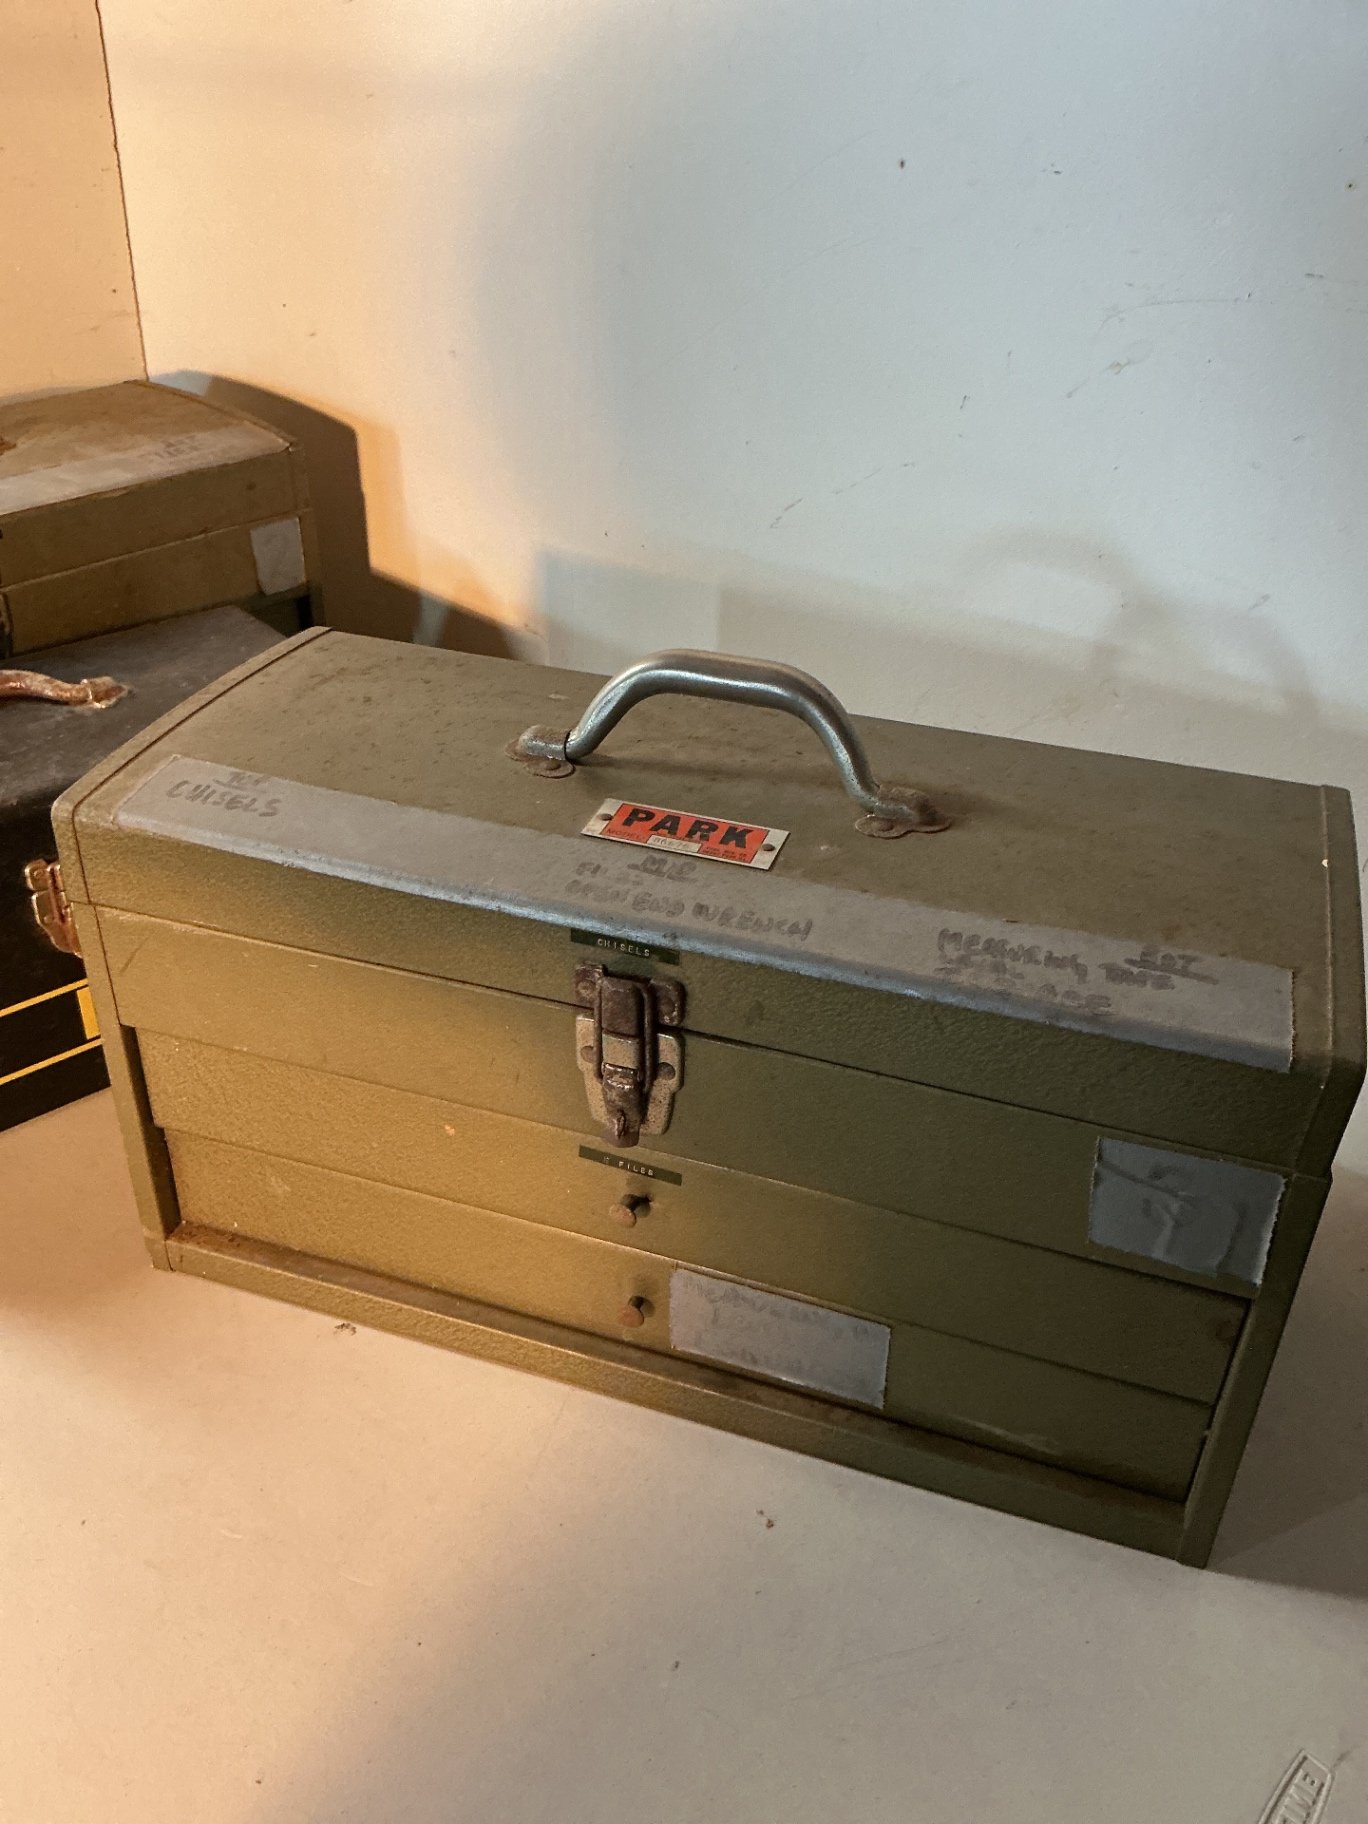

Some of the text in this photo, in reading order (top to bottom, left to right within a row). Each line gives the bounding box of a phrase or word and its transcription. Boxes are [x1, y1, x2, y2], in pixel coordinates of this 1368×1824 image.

[166, 780, 282, 817] CHISELS
[622, 807, 753, 849] PARK
[692, 902, 813, 942] WRENCH
[597, 938, 650, 957] CHISELS
[618, 1160, 654, 1177] FILES
